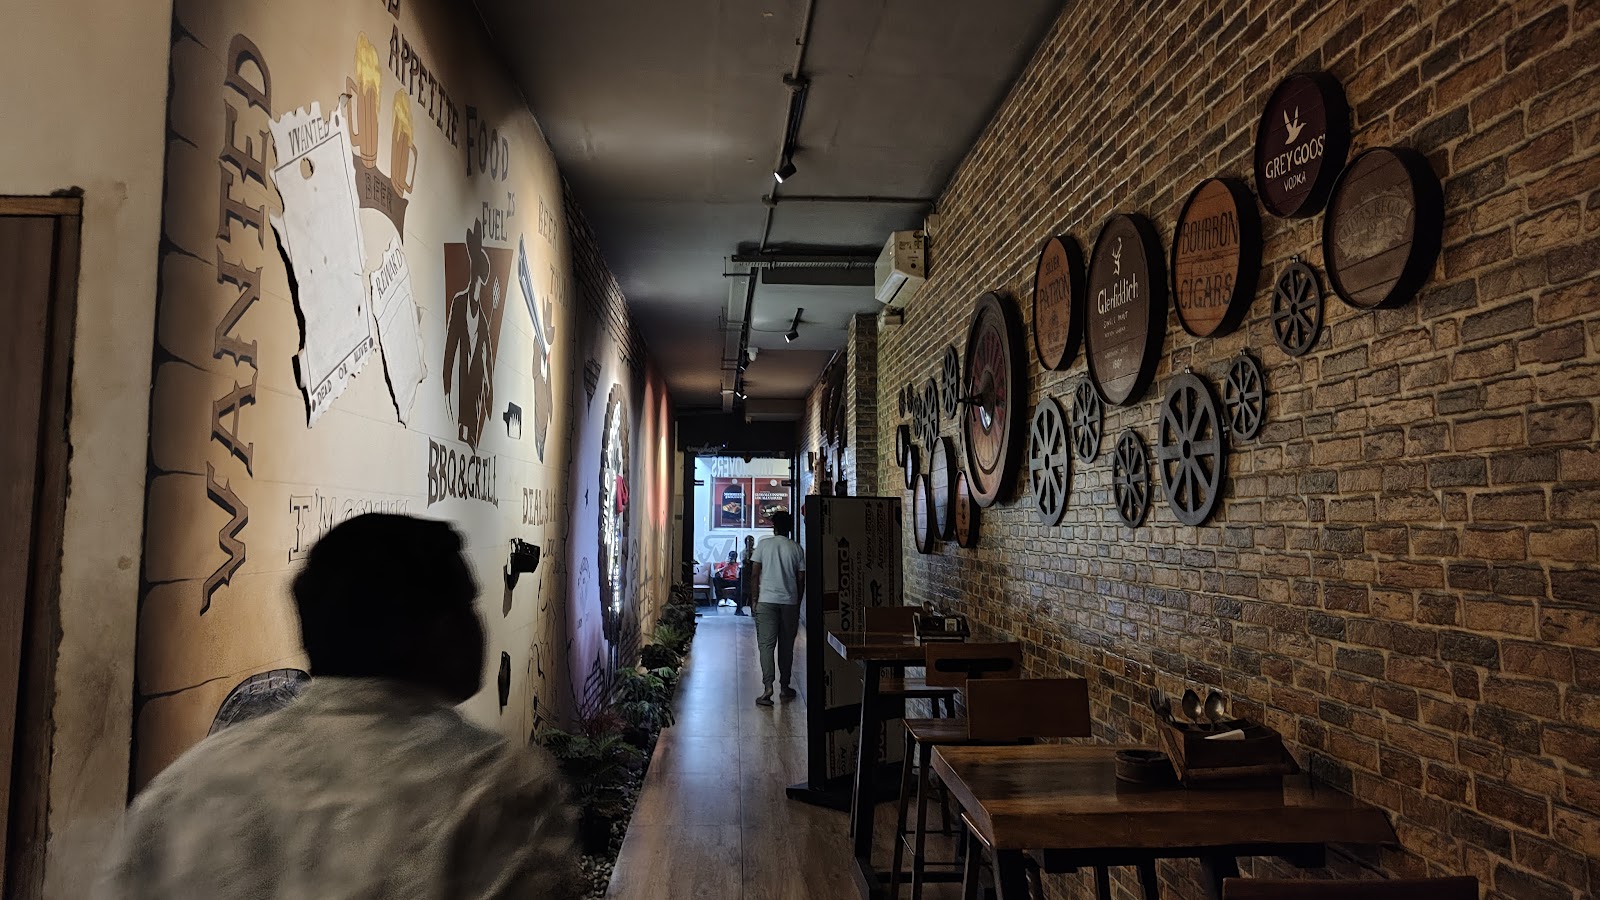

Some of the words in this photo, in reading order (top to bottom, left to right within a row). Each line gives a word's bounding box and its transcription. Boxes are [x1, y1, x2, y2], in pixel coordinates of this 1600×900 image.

[389, 24, 459, 149] APPETITE
[288, 118, 330, 157] WANTED
[465, 104, 509, 182] FOOD
[1293, 134, 1326, 166] GOOS
[364, 171, 393, 214] BEER
[1283, 170, 1307, 193] VODKA
[482, 201, 508, 242] FUEL
[1181, 211, 1239, 254] BOURBON
[1097, 272, 1140, 315] Glenfiddich
[1180, 271, 1233, 310] CIGARS
[199, 33, 273, 616] WANTED
[317, 379, 332, 406] DEAD
[865, 538, 873, 570] Arrow
